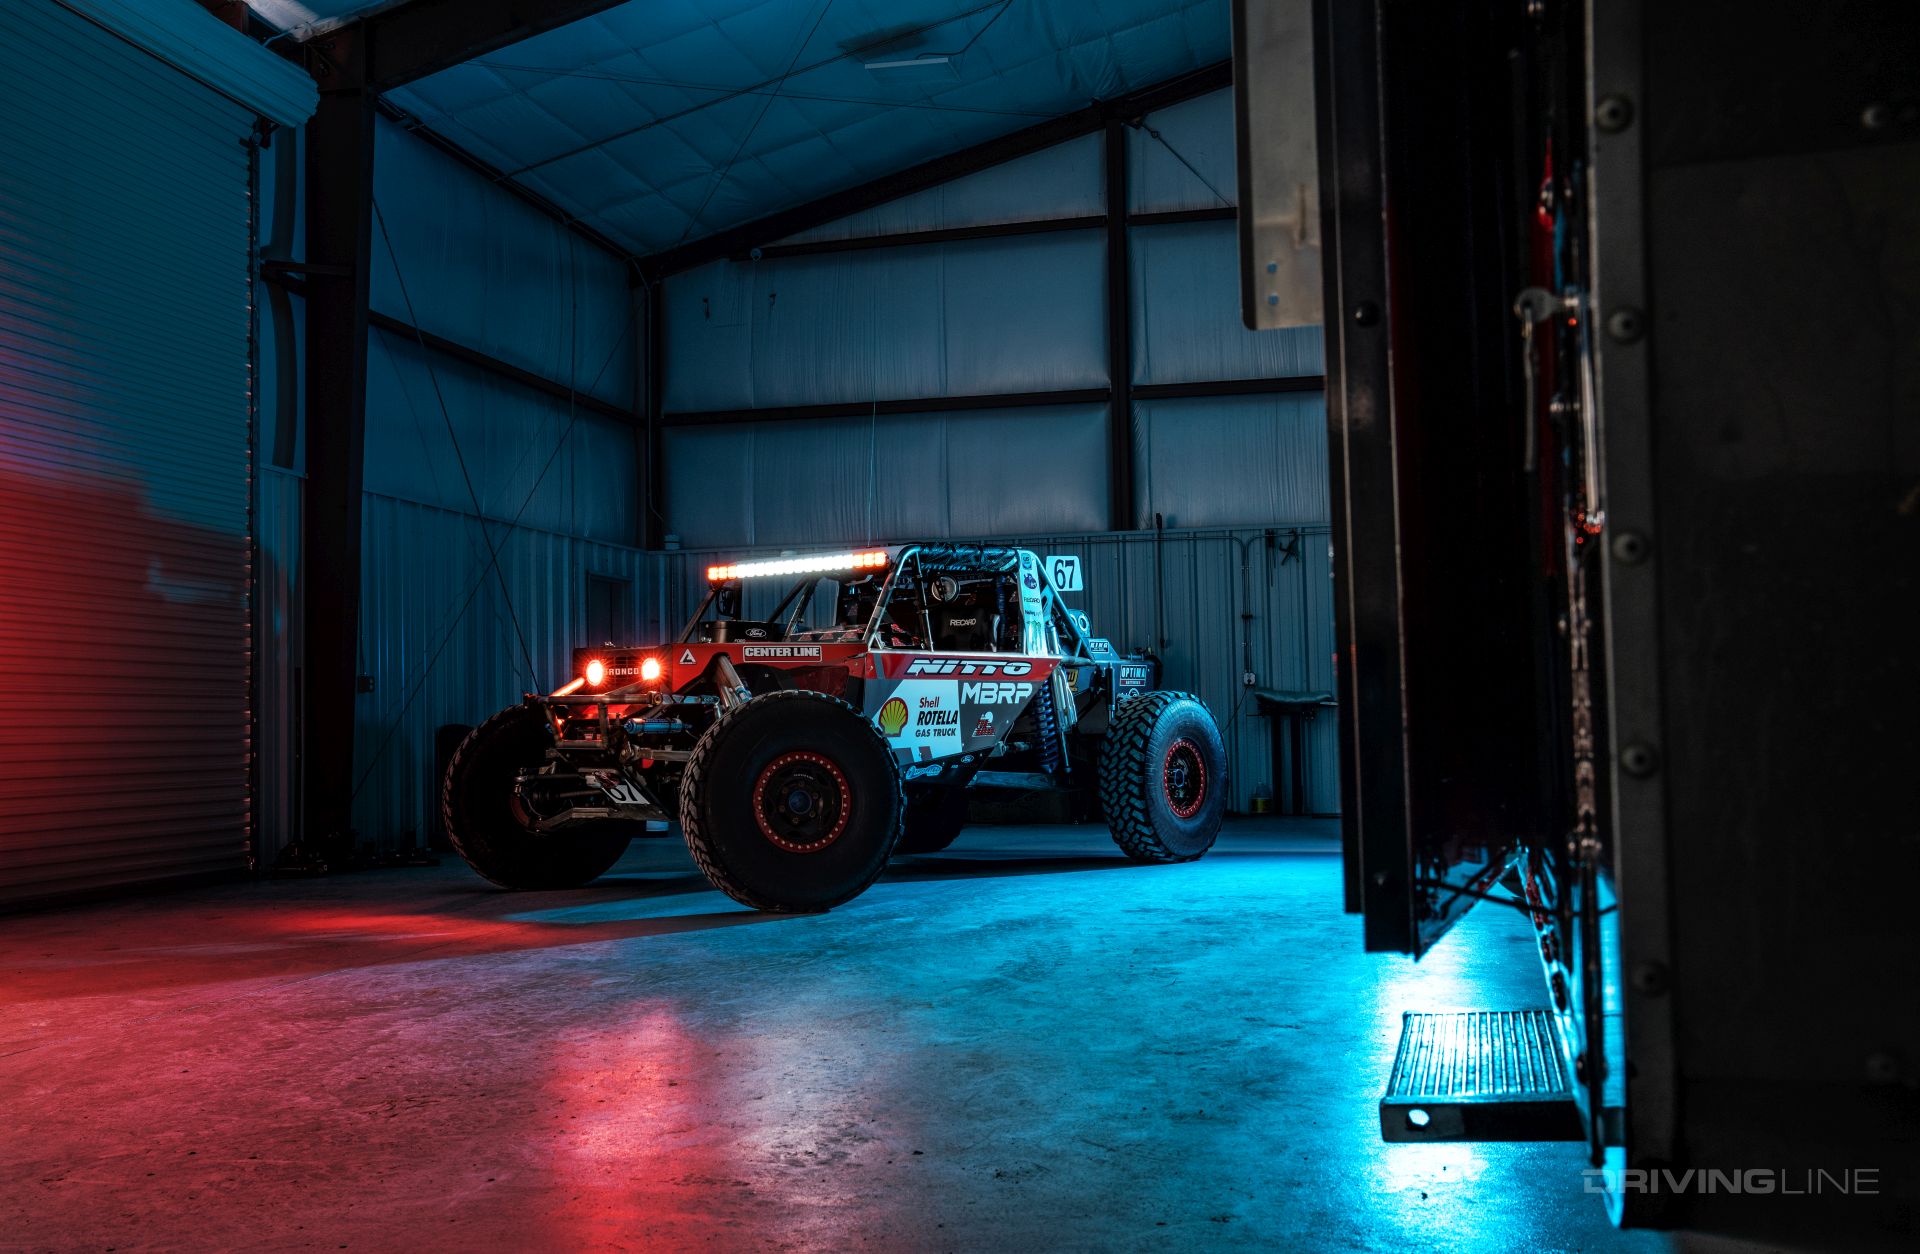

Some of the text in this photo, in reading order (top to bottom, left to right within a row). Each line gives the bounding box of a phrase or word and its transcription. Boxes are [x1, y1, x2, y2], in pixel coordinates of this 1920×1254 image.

[1054, 559, 1075, 589] 67
[949, 618, 977, 626] RECARO
[745, 647, 820, 657] CENTER LINE
[905, 658, 1033, 676] NITTO
[1121, 667, 1145, 678] OPTIMA
[961, 682, 1033, 705] MBRP
[919, 696, 940, 708] Shell
[916, 710, 959, 726] ROTELLA
[915, 727, 956, 737] GAS TRUCK
